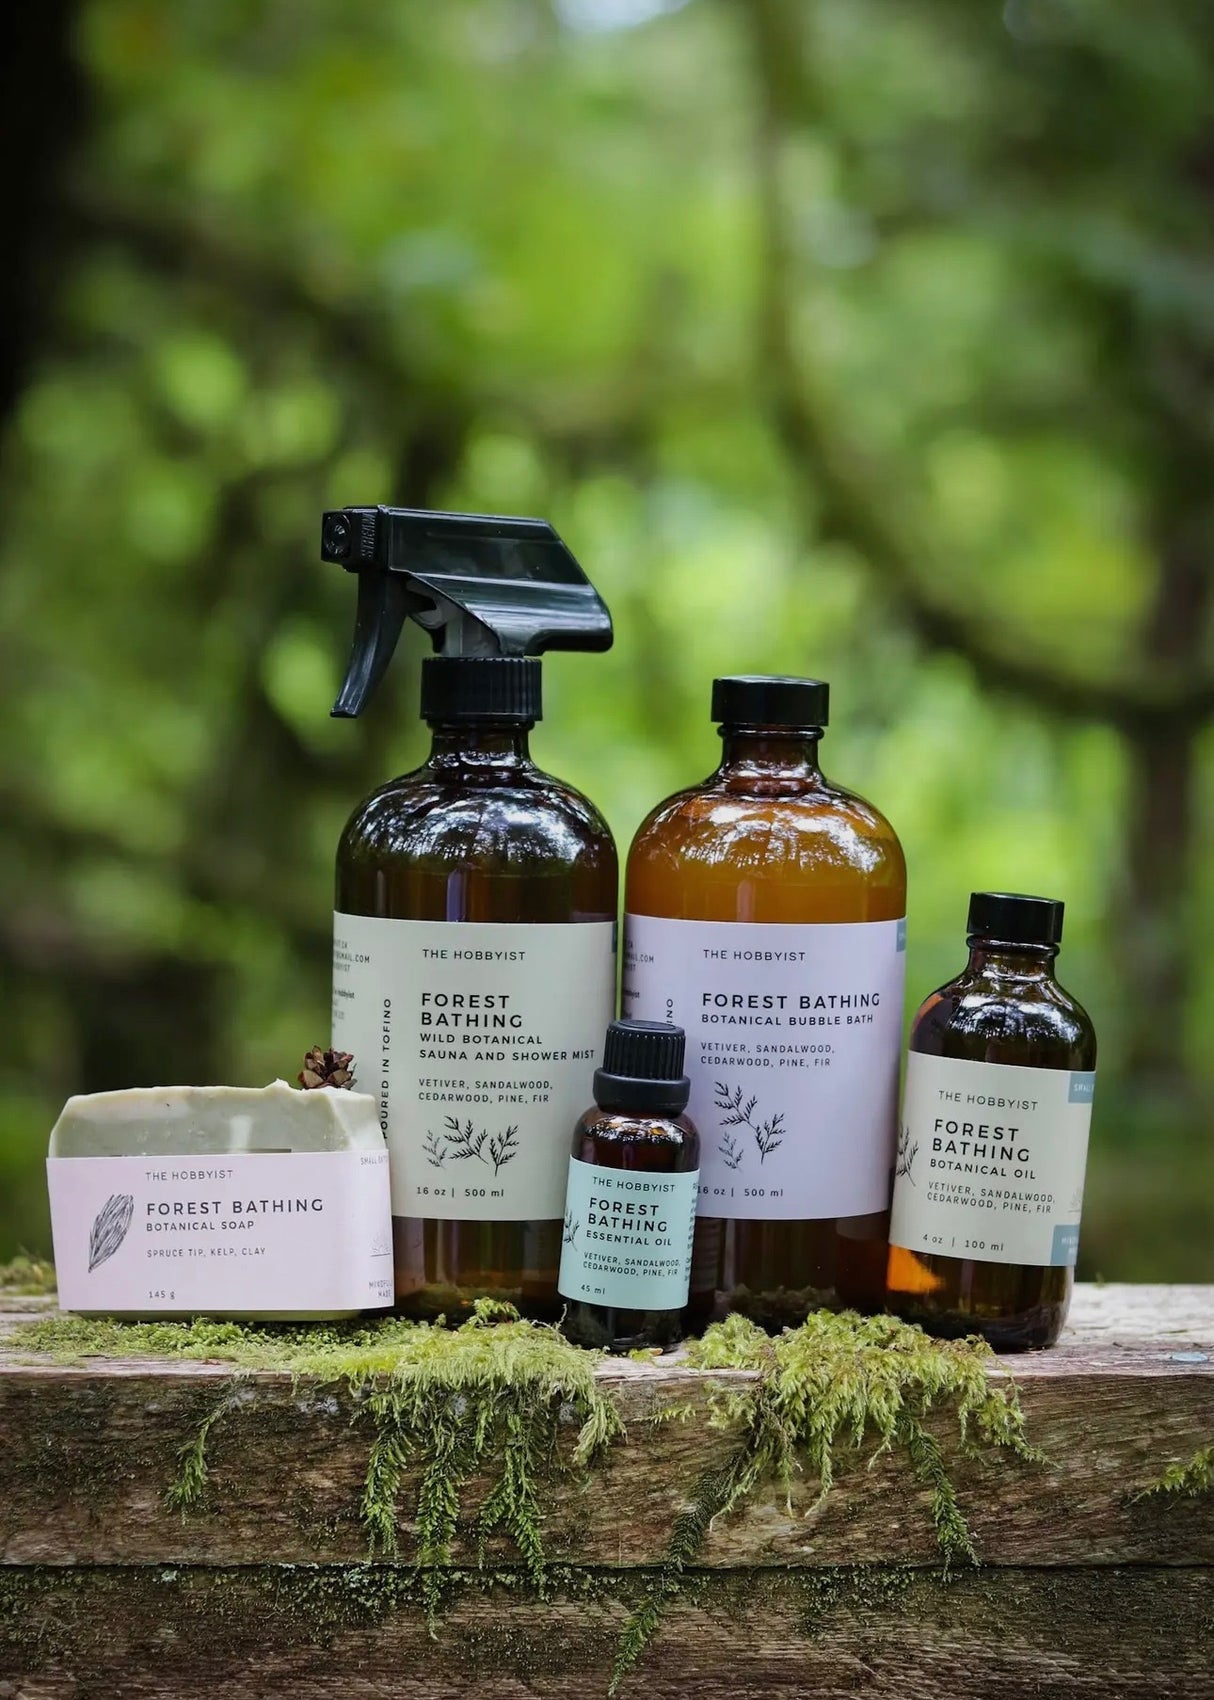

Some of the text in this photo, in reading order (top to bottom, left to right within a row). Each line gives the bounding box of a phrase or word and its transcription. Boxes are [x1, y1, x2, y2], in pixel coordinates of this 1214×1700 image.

[423, 949, 526, 961] THE HOBBYIST
[703, 949, 806, 961] THE HOBBYIST
[421, 993, 510, 1009] FOREST
[703, 993, 880, 1009] FOREST BATHING
[382, 999, 391, 1052] TOFINO
[421, 1012, 523, 1028] BATHING
[701, 1014, 873, 1026] BOTANICAL BUBBLE BATH
[420, 1033, 543, 1045] WILD BOTANICAL
[419, 1049, 595, 1061] SAUNA AND SHOWER MIST
[701, 1042, 835, 1054] VETIVER, SANDALWOOD,
[382, 1059, 390, 1073] IN
[701, 1055, 831, 1068] CEDARWOOD, PINE, FIR
[418, 1078, 553, 1090] VETIVER, SANDALWOOD,
[418, 1092, 550, 1104] CEDARWOOD, PINE, FIR
[938, 1090, 1038, 1111] THE HOBBYIST
[934, 1119, 1020, 1142] FOREST
[932, 1138, 1030, 1162] BATHING
[145, 1169, 234, 1181] THE HOBBYIST
[930, 1159, 1036, 1180] BOTANICAL OIL
[593, 1176, 676, 1193] THE HOBBYIST
[416, 1187, 429, 1196] 16
[465, 1188, 486, 1197] 500
[491, 1188, 504, 1198] ml
[744, 1188, 765, 1197] 500
[770, 1188, 784, 1197] ml
[928, 1181, 1055, 1204] VETIVER, SANDALWOOD,
[146, 1198, 324, 1216] FOREST BATHING
[589, 1197, 659, 1216] FOREST
[927, 1192, 1051, 1213] CEDARWOOD, PINE, FIR
[146, 1220, 255, 1232] BOTANICAL SOAP
[588, 1213, 668, 1232] BATHING
[586, 1230, 672, 1246] ESSENTIAL OIL
[932, 1236, 943, 1244] oz
[964, 1239, 985, 1250] 100
[990, 1242, 1004, 1251] ml
[147, 1246, 266, 1258] SPRUCE TIP, KELP, CLAY
[584, 1252, 680, 1267] VETIVER, SANDALWOOD,
[583, 1261, 678, 1277] CEDARWOOD, PINE, FIR
[149, 1290, 175, 1300] 145 g
[580, 1284, 605, 1295] 45 ml
